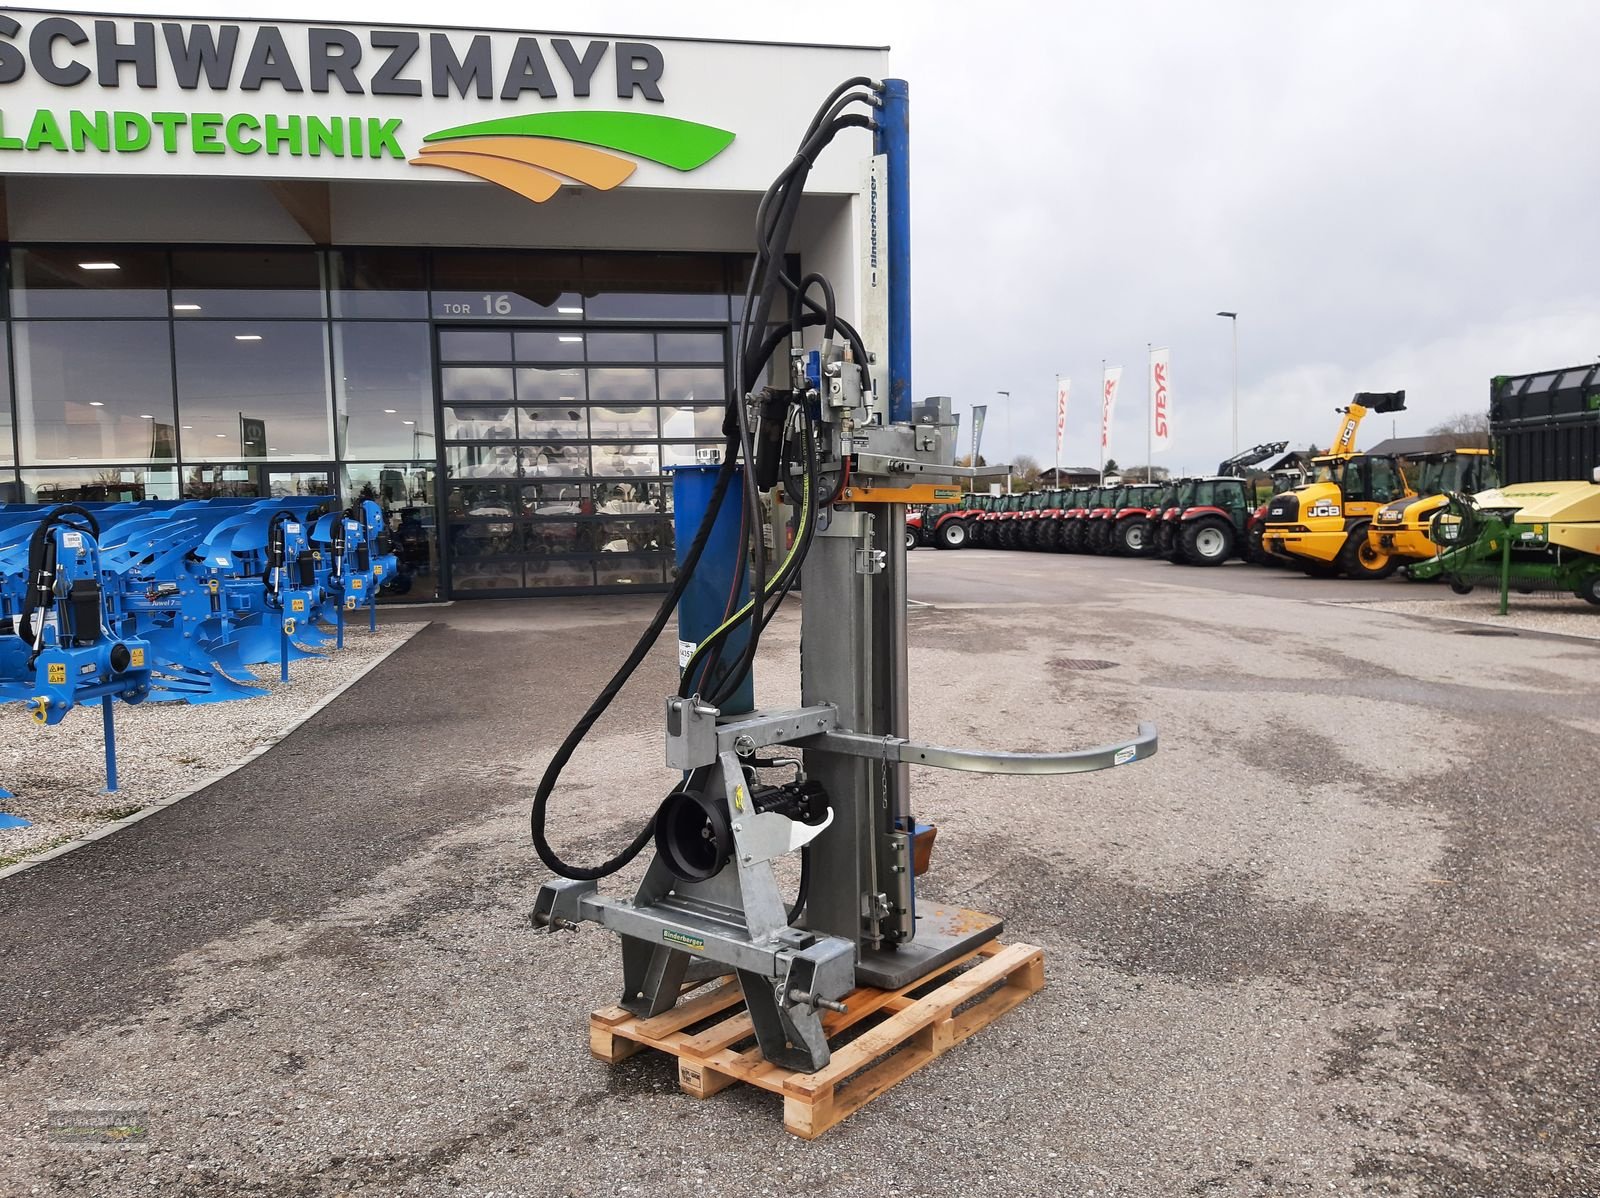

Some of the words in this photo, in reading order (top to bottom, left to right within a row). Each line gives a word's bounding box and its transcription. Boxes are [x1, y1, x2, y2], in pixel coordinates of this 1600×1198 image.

[0, 108, 406, 159] LANDTECHNIK
[870, 175, 878, 268] Binderberger
[443, 303, 471, 314] TOR
[483, 294, 512, 315] 16
[1154, 362, 1168, 438] STEYR
[1342, 420, 1356, 446] JCB
[1308, 506, 1340, 517] JCB
[152, 599, 169, 607] Juwel
[663, 930, 704, 947] Binderberger
